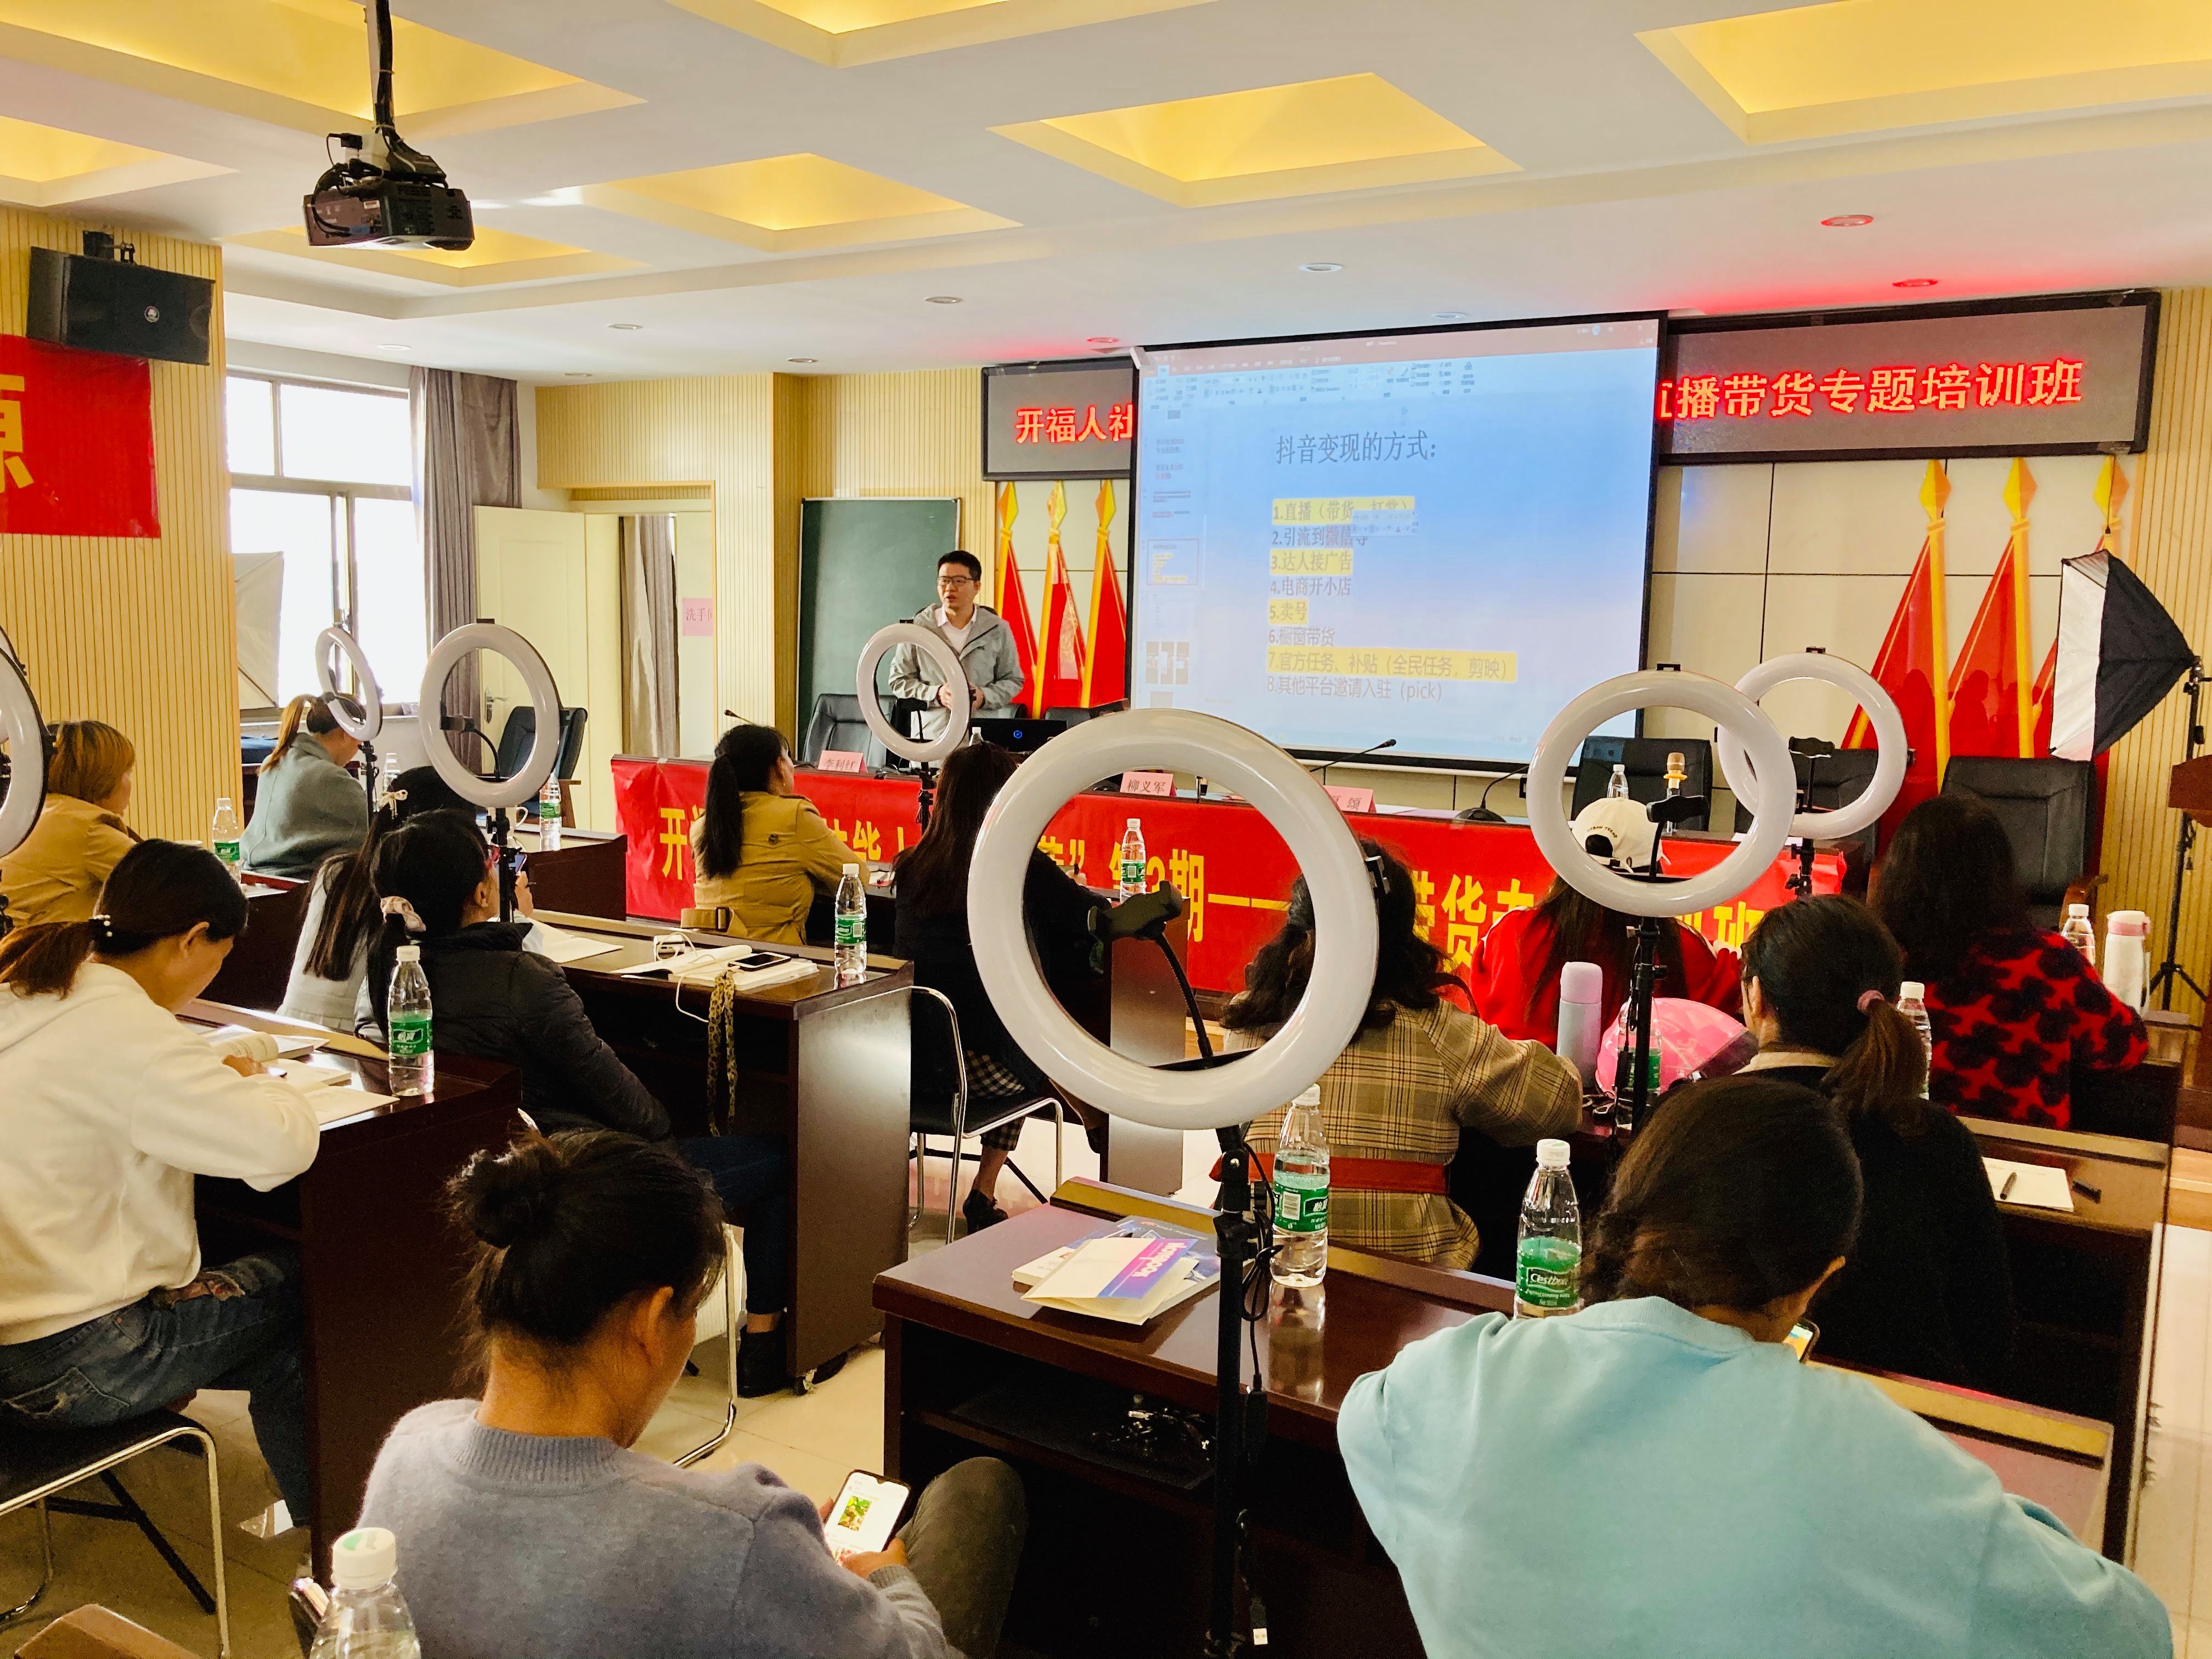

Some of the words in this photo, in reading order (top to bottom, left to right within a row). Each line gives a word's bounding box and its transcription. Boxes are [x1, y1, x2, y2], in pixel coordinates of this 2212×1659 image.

[1015, 403, 1133, 444] 开福人社
[1271, 551, 1352, 572] 3.达人接广告
[1269, 577, 1352, 596] 4.电商开小店
[1269, 601, 1307, 621] 5.卖号
[1268, 627, 1336, 646] 6.橱窗带货
[1127, 779, 1166, 794] 柳义军
